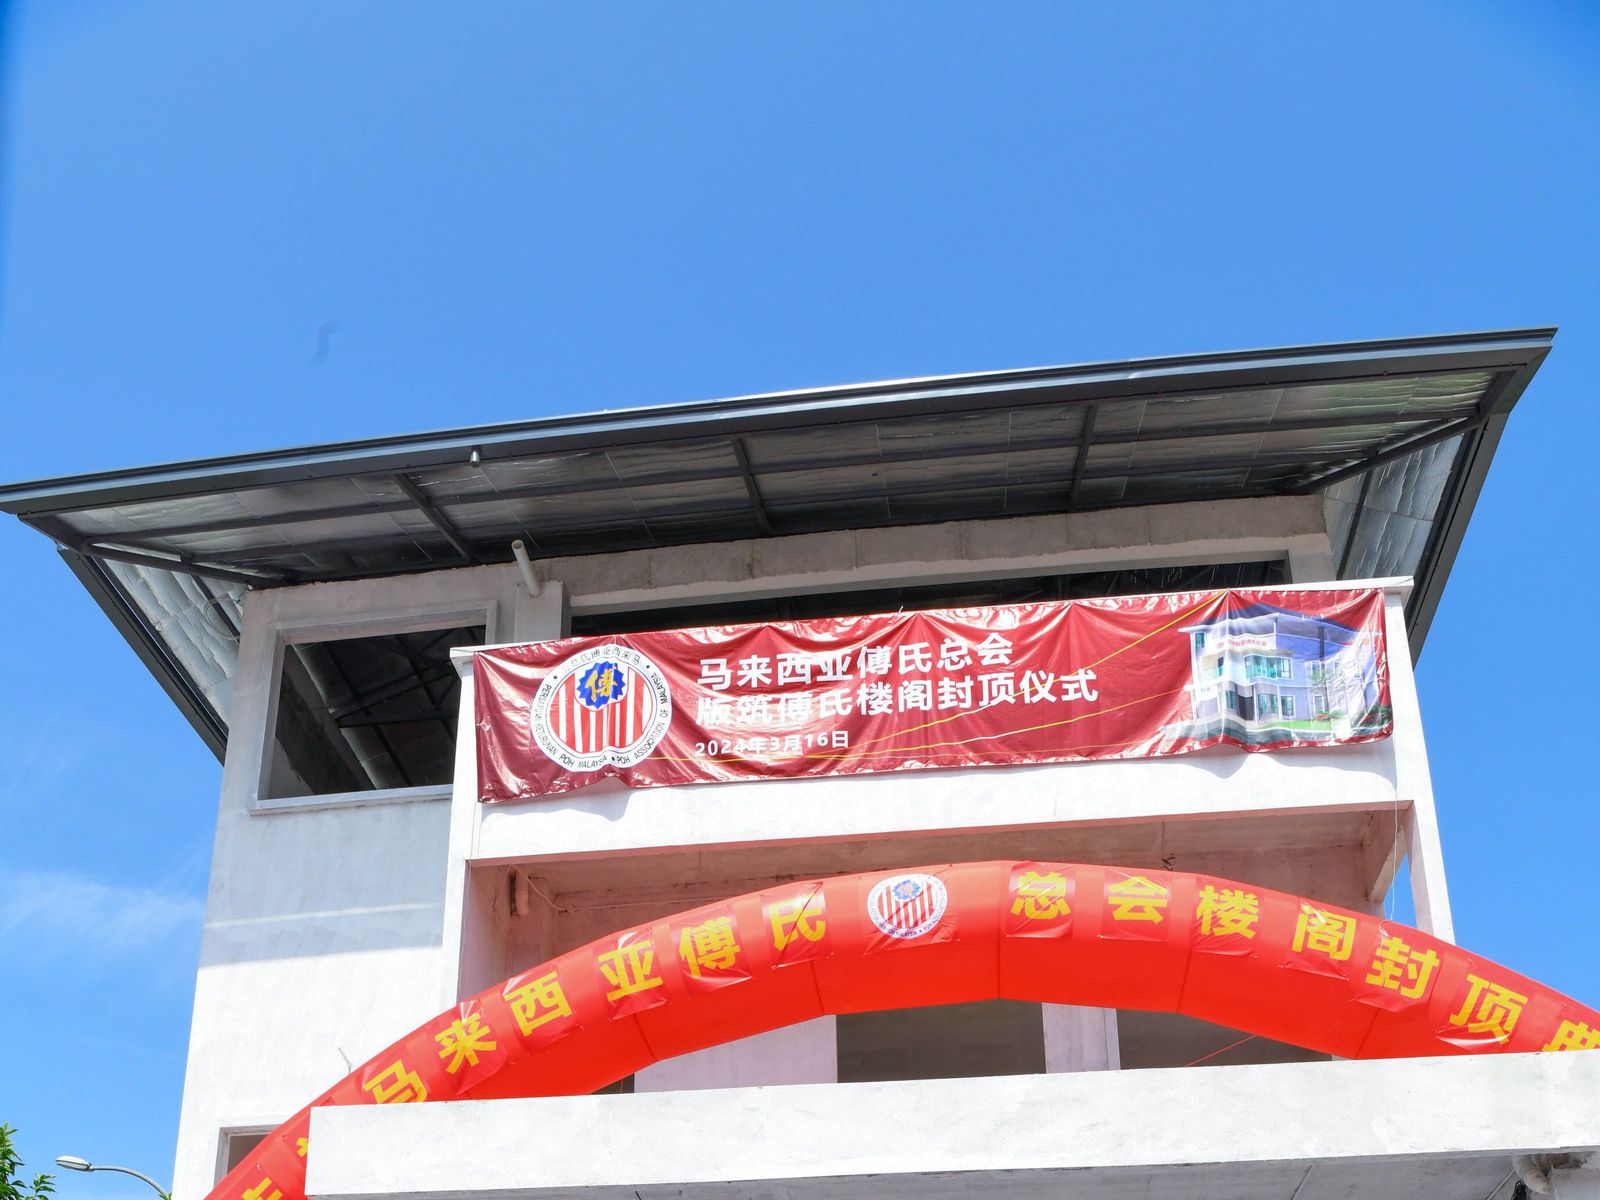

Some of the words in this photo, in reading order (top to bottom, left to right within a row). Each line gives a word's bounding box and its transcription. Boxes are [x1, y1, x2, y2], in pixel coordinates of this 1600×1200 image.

[697, 632, 1013, 691] 马来西亚傅氏总会
[650, 672, 669, 705] MALAYSIA
[660, 709, 669, 719] OF
[634, 722, 666, 760] ASSOCIATION
[694, 731, 849, 757] 2024年3月16日
[559, 753, 575, 768] POH
[578, 755, 608, 768] MALAYSIA
[616, 756, 631, 764] POH
